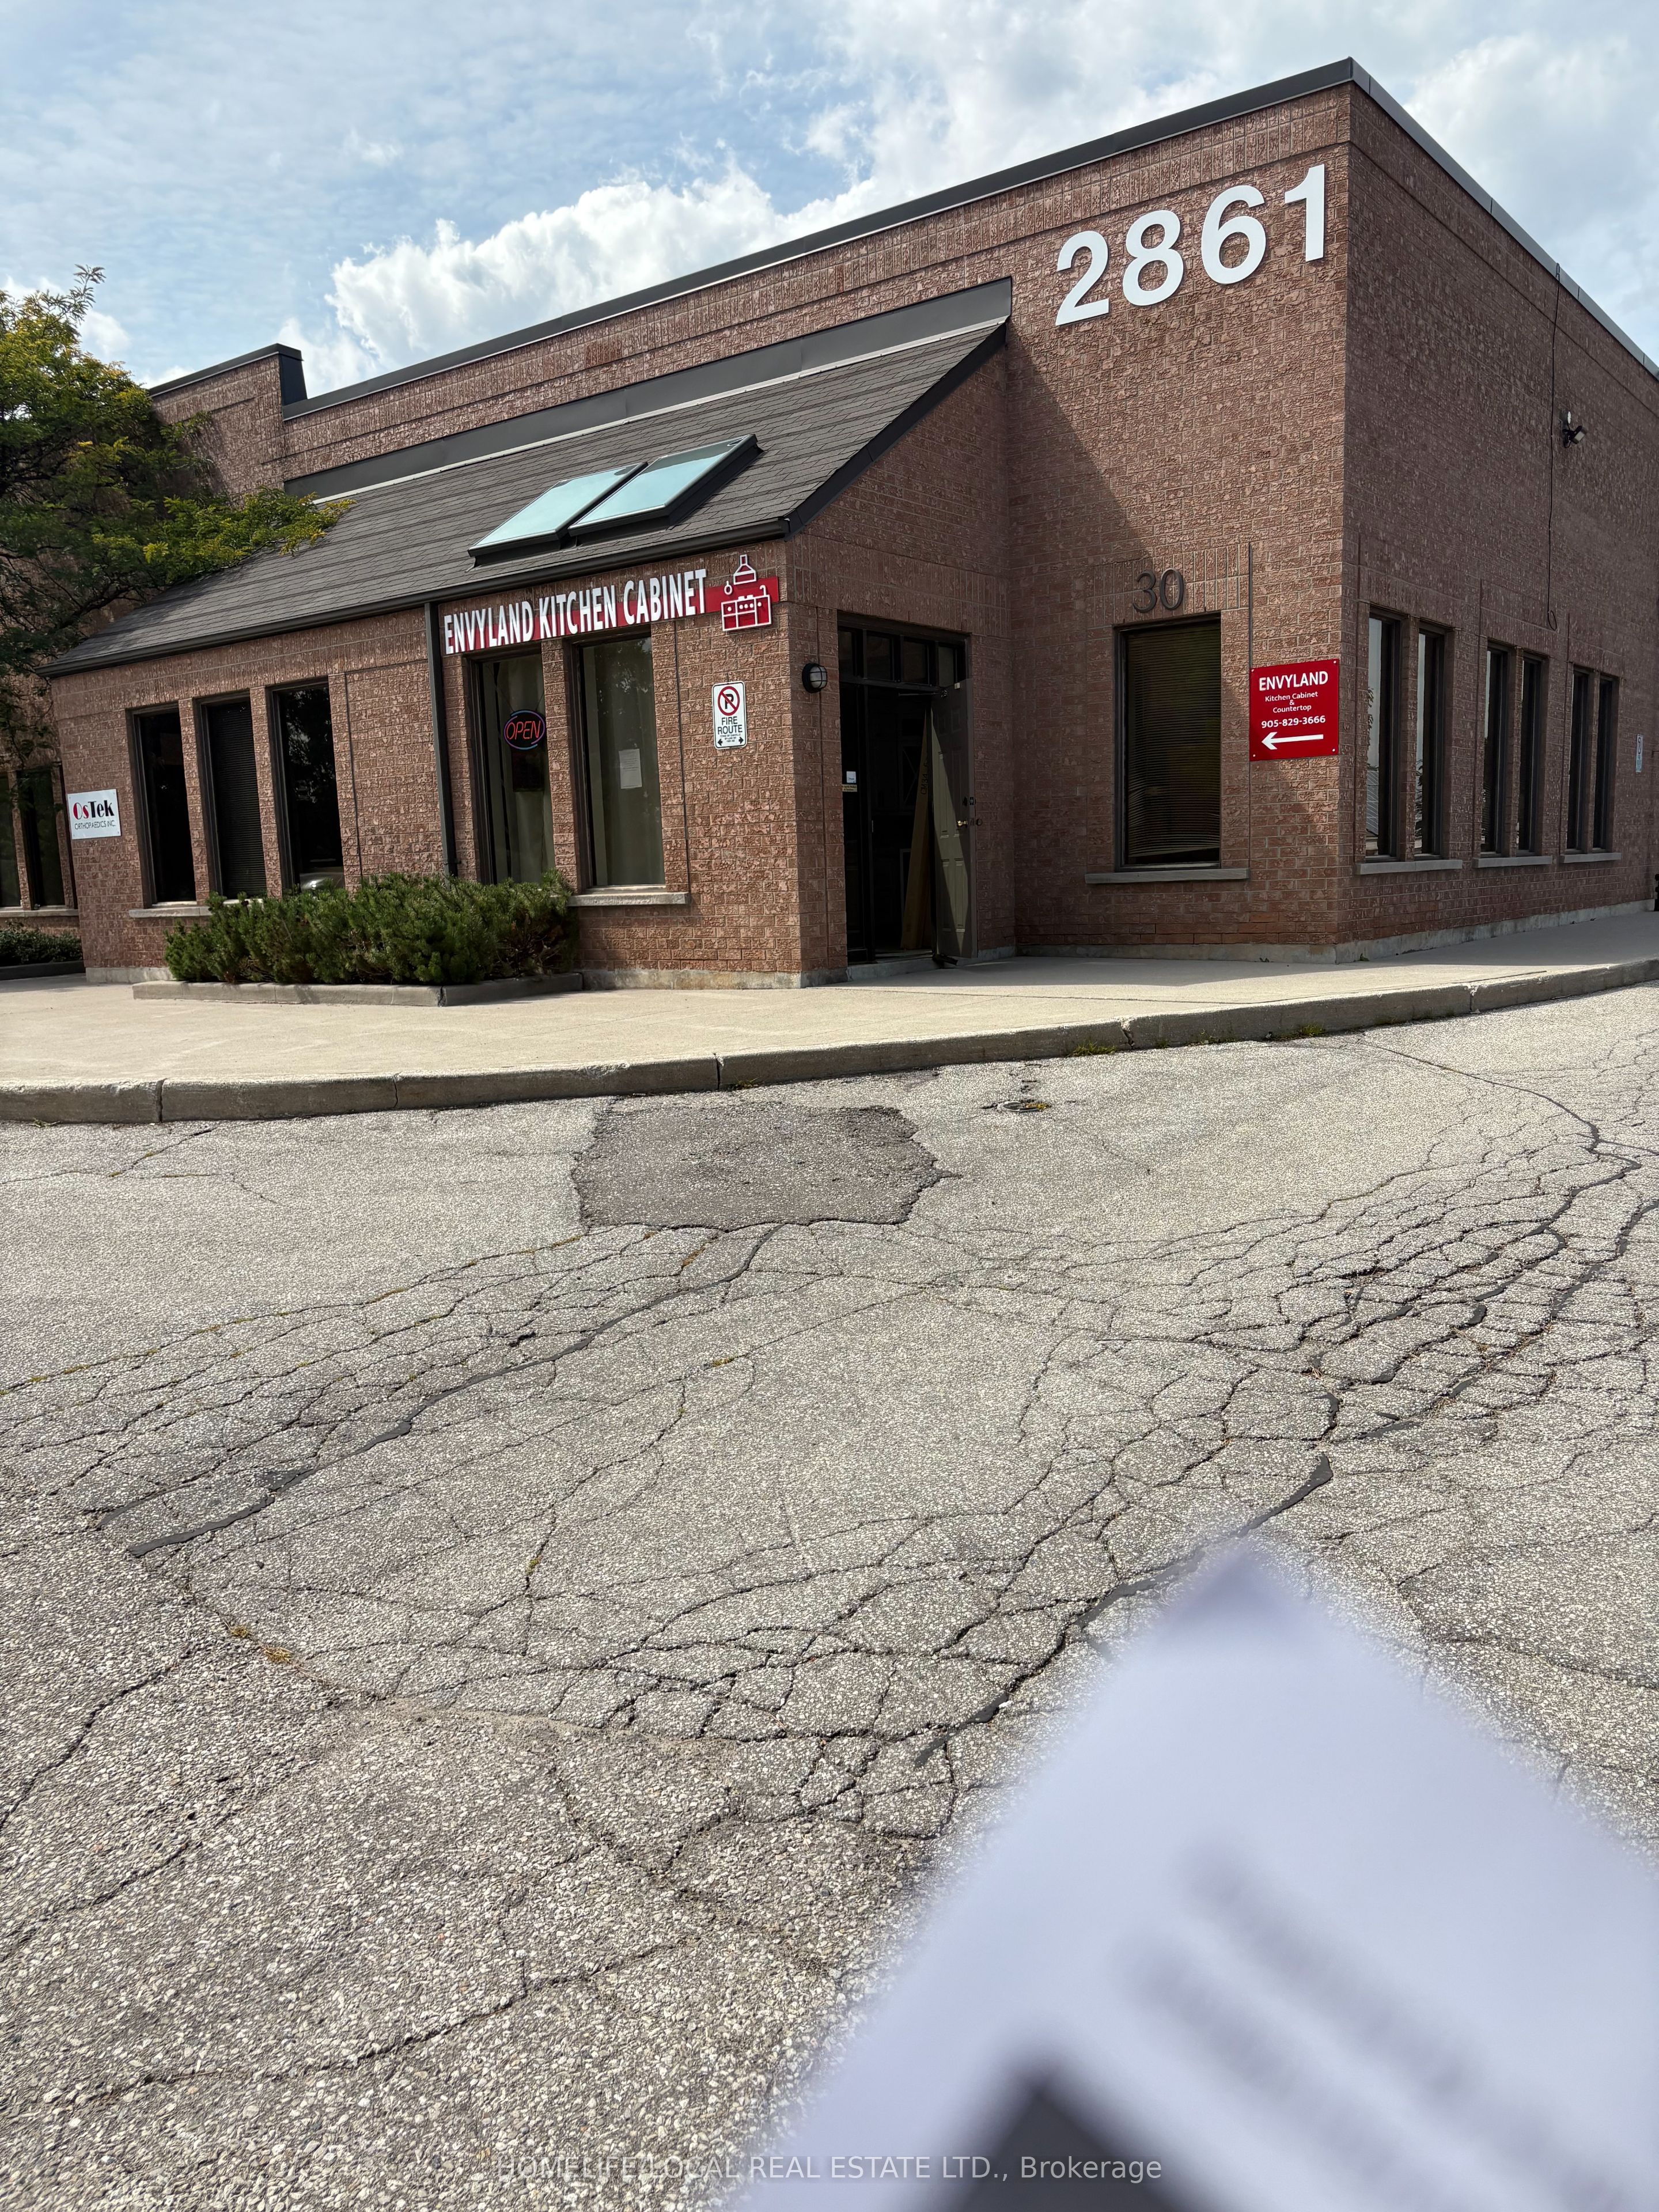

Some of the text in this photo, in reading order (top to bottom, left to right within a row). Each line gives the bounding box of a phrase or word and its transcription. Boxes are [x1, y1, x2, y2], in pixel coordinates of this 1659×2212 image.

[1055, 164, 1325, 326] 2861
[1132, 567, 1184, 613] 30
[444, 569, 706, 654] ENVYLAND KITCHEN CABINET
[1259, 671, 1328, 691] ENVYLAND
[1265, 691, 1318, 702] Kitchen Cabinet
[1273, 704, 1312, 714] Countertop
[722, 717, 738, 725] FIRE
[1261, 715, 1325, 728] 905-829-3666
[506, 721, 541, 740] OPEN
[718, 725, 743, 734] ROUTE
[73, 800, 114, 820] OsTek
[75, 821, 107, 830] ORTHOPAEDICS
